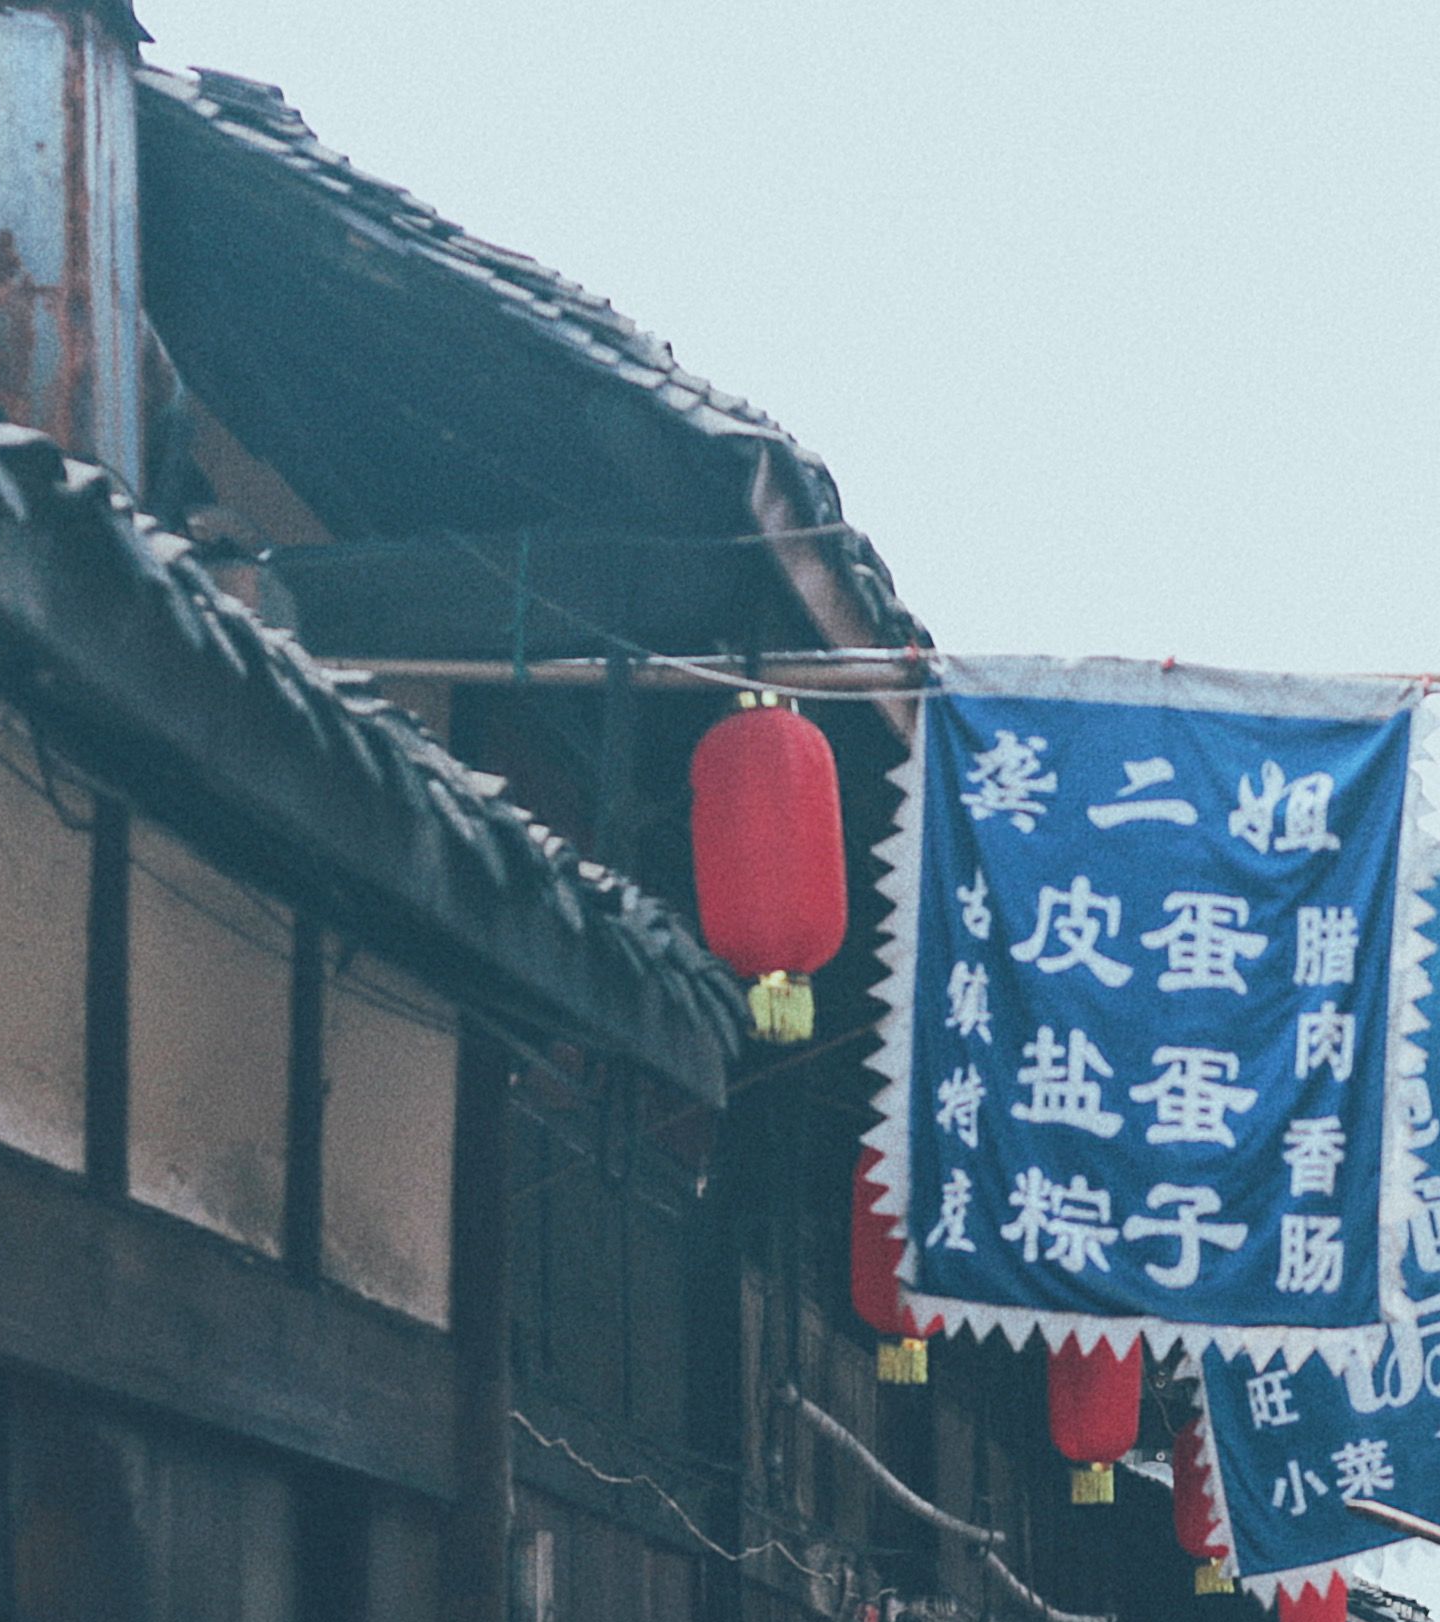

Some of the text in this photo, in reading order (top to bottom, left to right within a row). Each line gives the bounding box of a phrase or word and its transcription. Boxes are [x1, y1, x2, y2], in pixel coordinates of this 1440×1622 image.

[960, 729, 1342, 855] 龚二姐
[1009, 875, 1269, 995] 皮蛋
[1009, 1025, 1259, 1149] 盐蛋
[1275, 906, 1360, 1293] 腊肉香肠
[1001, 1166, 1250, 1289] 粽子
